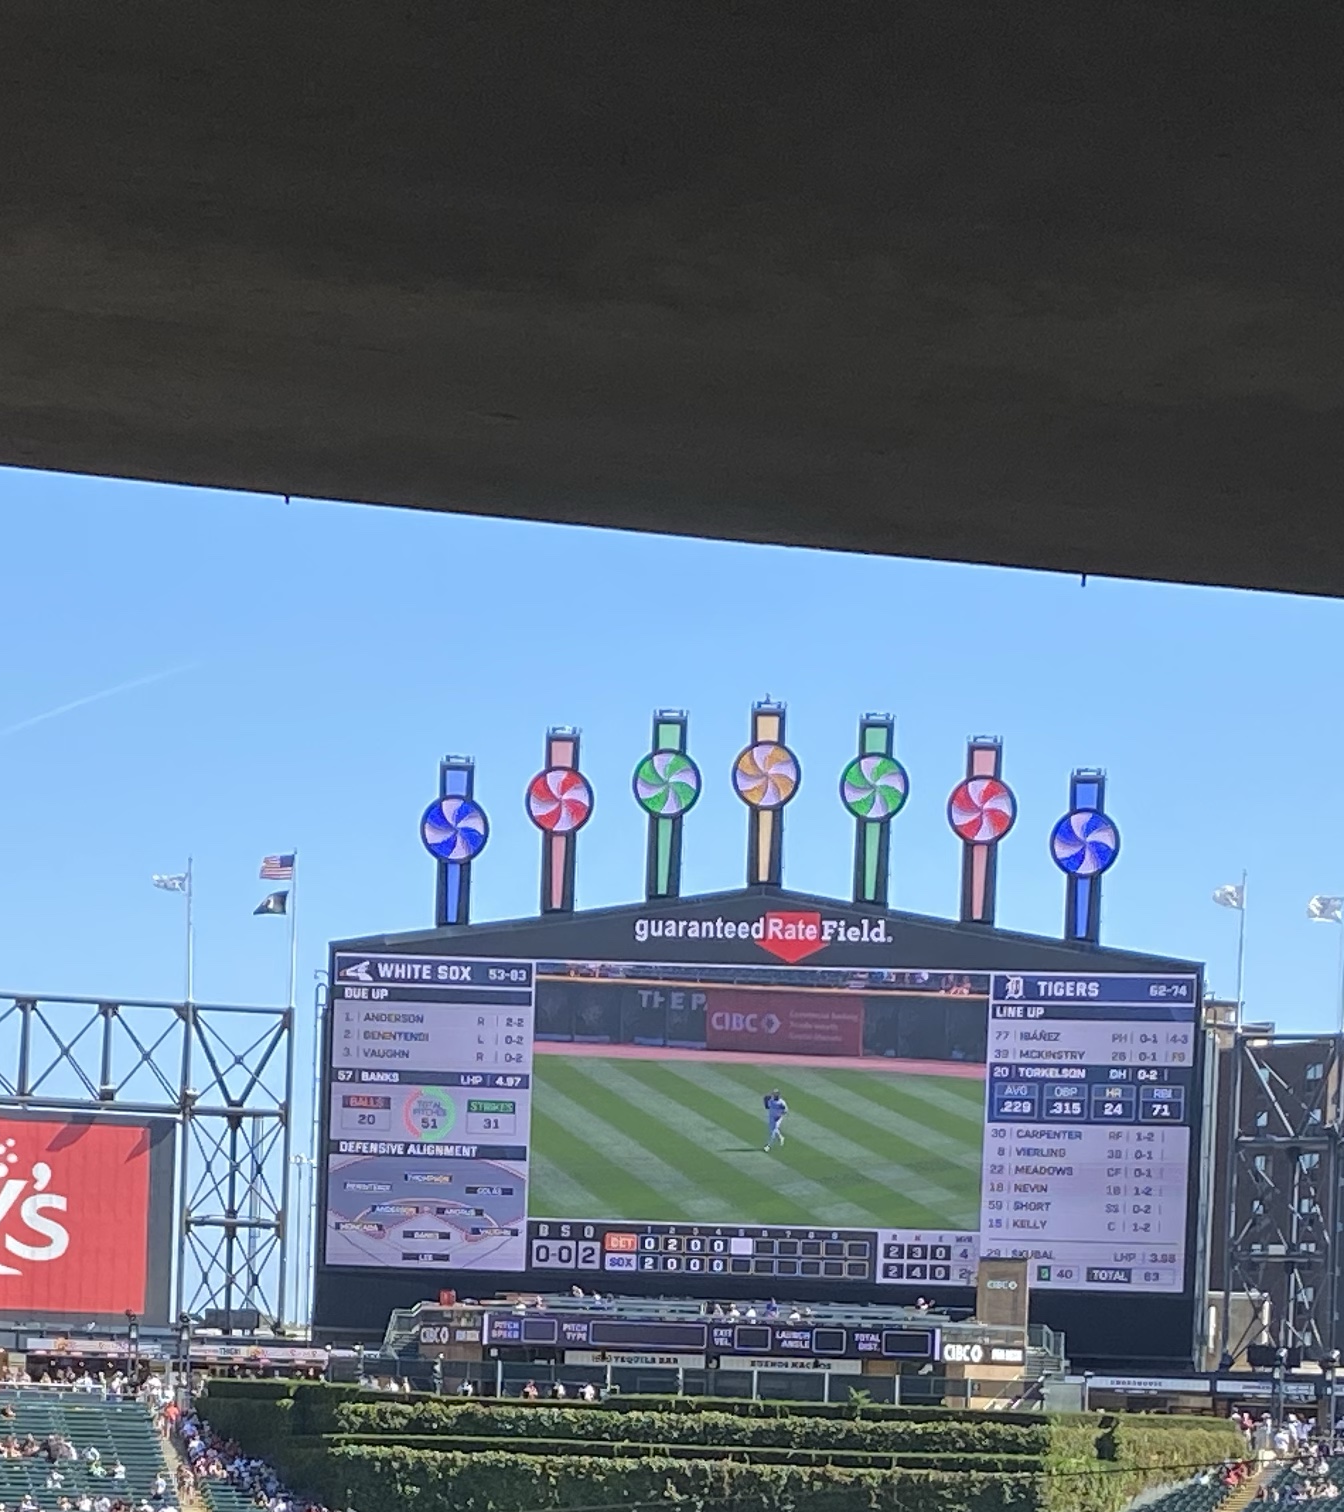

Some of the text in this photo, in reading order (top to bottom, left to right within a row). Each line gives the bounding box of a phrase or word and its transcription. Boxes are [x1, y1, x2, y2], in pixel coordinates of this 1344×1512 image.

[635, 916, 764, 941] guaranteed
[768, 919, 818, 940] Rate
[378, 963, 471, 980] WHITE SOX
[345, 988, 388, 999] DUE UP
[1037, 981, 1187, 996] TIGERS 62-74
[996, 1007, 1044, 1018] LINE UP
[364, 1013, 424, 1024] ANDERSON
[712, 1012, 758, 1032] CIBC
[338, 1071, 482, 1085] 57 BANKS LHP
[993, 1067, 1085, 1078] 20 TORKELSON
[1000, 1102, 1170, 1115] .229 .315 24 71
[358, 1115, 375, 1125] 20
[421, 1118, 437, 1128] 51
[484, 1119, 499, 1129] 31
[1017, 1129, 1082, 1140] CARPENTER
[340, 1141, 476, 1157] DEFENSIVE ALIGNMENT
[1015, 1165, 1073, 1175] MEADOWS
[1014, 1184, 1047, 1193] NEVIN
[1013, 1202, 1051, 1211] SHORT
[1013, 1220, 1047, 1229] KELLY
[536, 1245, 594, 1263] 0-0 2
[610, 1257, 633, 1267] SOX
[1093, 1270, 1128, 1280] TOTAL
[564, 1324, 587, 1332] PITCH
[566, 1333, 586, 1341] TYPE
